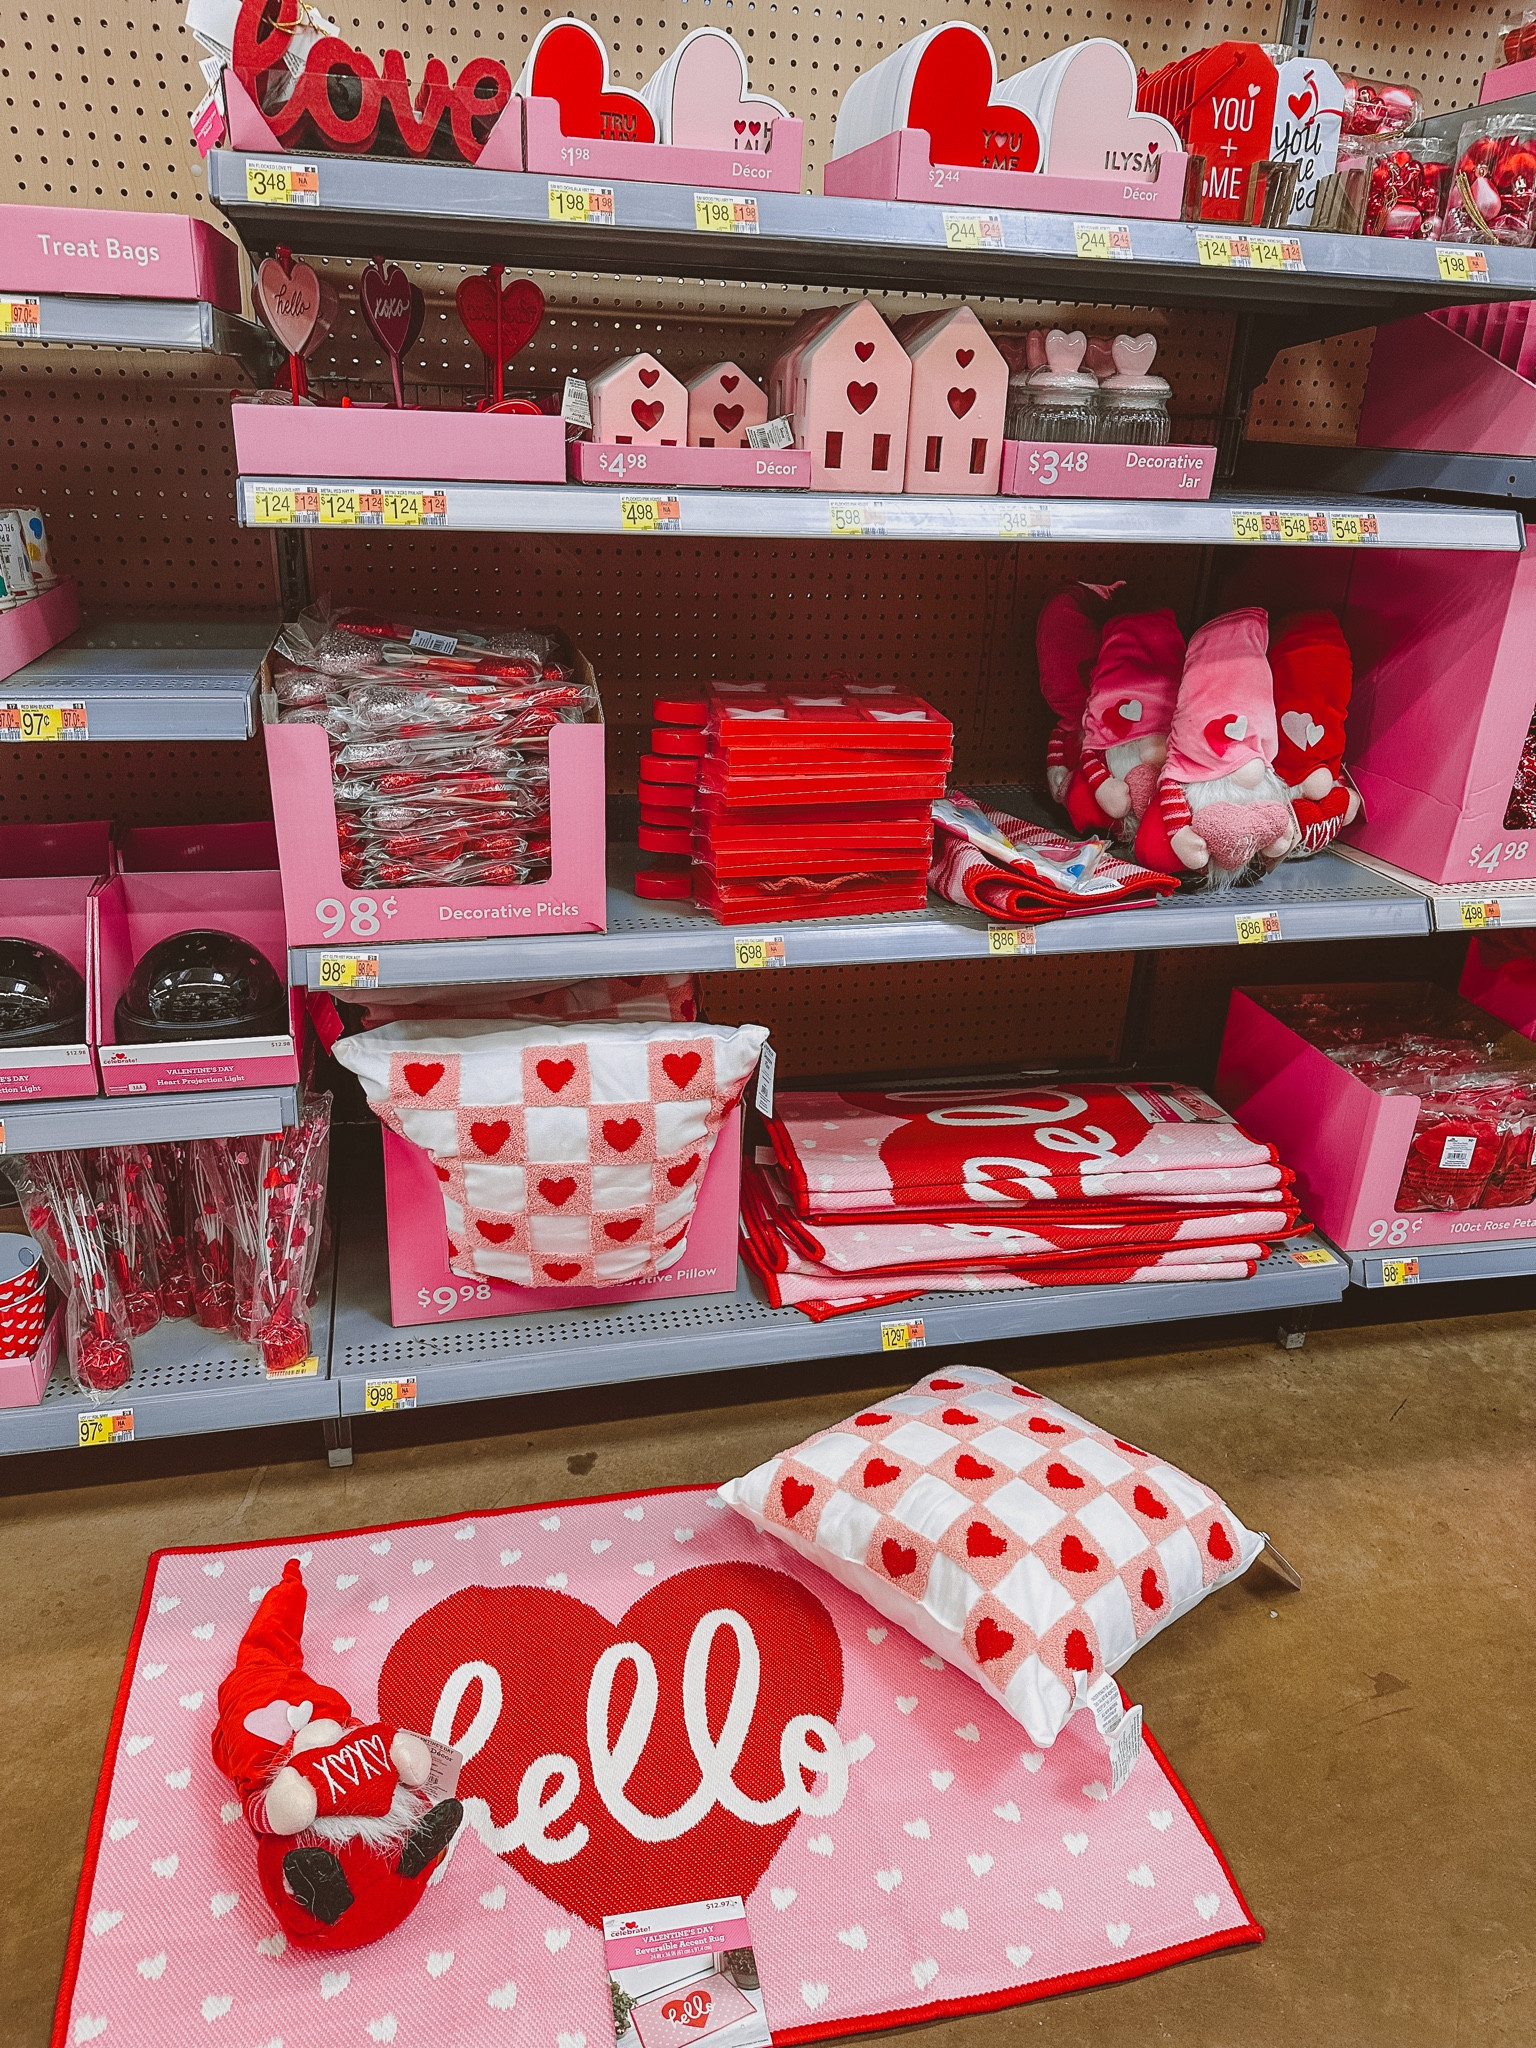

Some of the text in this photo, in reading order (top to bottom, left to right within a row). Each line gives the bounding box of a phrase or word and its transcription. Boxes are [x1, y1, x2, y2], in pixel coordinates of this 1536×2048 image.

[600, 111, 637, 132] TRU
[1212, 96, 1256, 133] YOU
[560, 147, 590, 166] $198
[1104, 150, 1161, 173] ILYSM
[732, 162, 772, 179] Décor
[928, 169, 960, 188] $244
[249, 171, 286, 195] $348
[1210, 166, 1241, 200] ME
[1123, 185, 1159, 201] Décor
[550, 192, 584, 214] $198
[589, 195, 613, 211] $198
[696, 203, 730, 225] $198
[734, 206, 756, 220] $198
[945, 222, 977, 242] $244
[1076, 232, 1106, 251] $244
[37, 234, 160, 266] Treat Bags
[1199, 241, 1227, 260] $124
[1251, 245, 1279, 263] $124
[1439, 257, 1465, 275] $198
[273, 283, 311, 315] hello
[599, 453, 647, 478] $498
[756, 460, 798, 476] Décor
[1029, 451, 1088, 485] $348
[1125, 452, 1203, 470] Decorative
[1178, 475, 1202, 490] Jar
[256, 495, 290, 517] $124
[294, 496, 318, 510] $124
[321, 496, 355, 518] $124
[359, 498, 382, 511] $124
[385, 498, 418, 519] $124
[422, 499, 445, 512] $124
[622, 504, 653, 525] $498
[831, 510, 860, 529] $598
[1232, 518, 1259, 536] $548
[1280, 519, 1305, 537] $548
[1332, 521, 1357, 538] $548
[22, 713, 50, 736] 97¢
[1468, 841, 1529, 874] $498
[315, 895, 398, 939] 98¢
[439, 902, 579, 921] Decorative Picks
[1461, 907, 1483, 923] $498
[1237, 921, 1261, 939] $886
[990, 932, 1014, 950] $886
[736, 945, 762, 964] $698
[322, 962, 346, 981] 98¢
[157, 1075, 245, 1086] Heart Projection Light
[166, 1067, 217, 1075] VALENTINE'S
[20, 1085, 42, 1093] Light
[1368, 1217, 1423, 1247] 98¢
[1450, 1222, 1481, 1233] 100ct
[1483, 1220, 1511, 1232] Rose
[677, 1267, 718, 1281] Pillow
[1384, 1266, 1398, 1282] 98¢
[417, 1284, 491, 1315] $998
[882, 1329, 905, 1347] $1297
[366, 1387, 393, 1406] $998
[80, 1422, 103, 1442] 97¢
[424, 1608, 876, 1886] hello
[430, 1747, 453, 1762] Décor
[705, 1901, 730, 1910] $12.97
[610, 1925, 651, 1938] celebrate!
[642, 1925, 714, 1943] VALENTINE'S DAY
[635, 1934, 725, 1956] Reversible Accent Rug
[668, 1995, 716, 2028] hello
